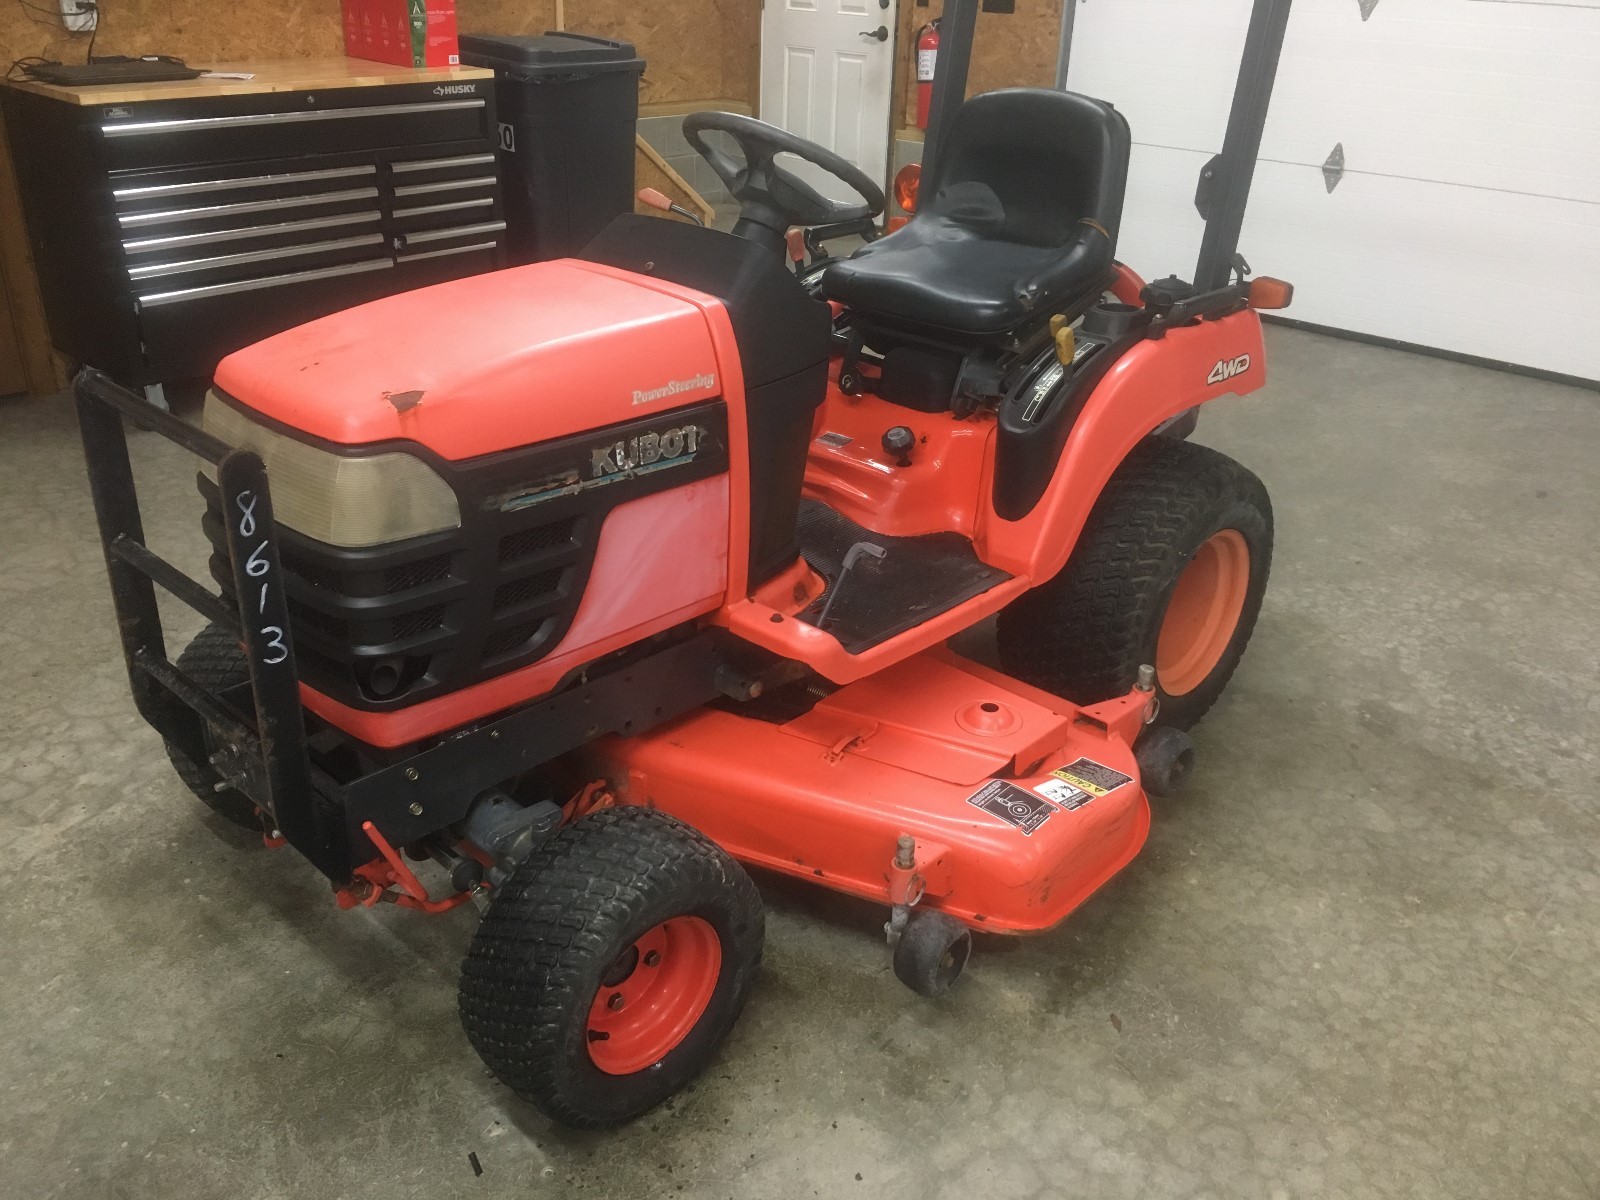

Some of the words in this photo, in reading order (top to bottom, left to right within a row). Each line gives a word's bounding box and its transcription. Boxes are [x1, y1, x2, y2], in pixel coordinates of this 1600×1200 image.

[444, 84, 476, 95] HUSKY
[498, 125, 513, 150] 0
[1207, 353, 1250, 386] 4WD
[632, 373, 715, 406] PowerSteering
[592, 424, 706, 478] KUBOT
[236, 490, 288, 664] 8613
[1055, 770, 1092, 788] CAUTION
